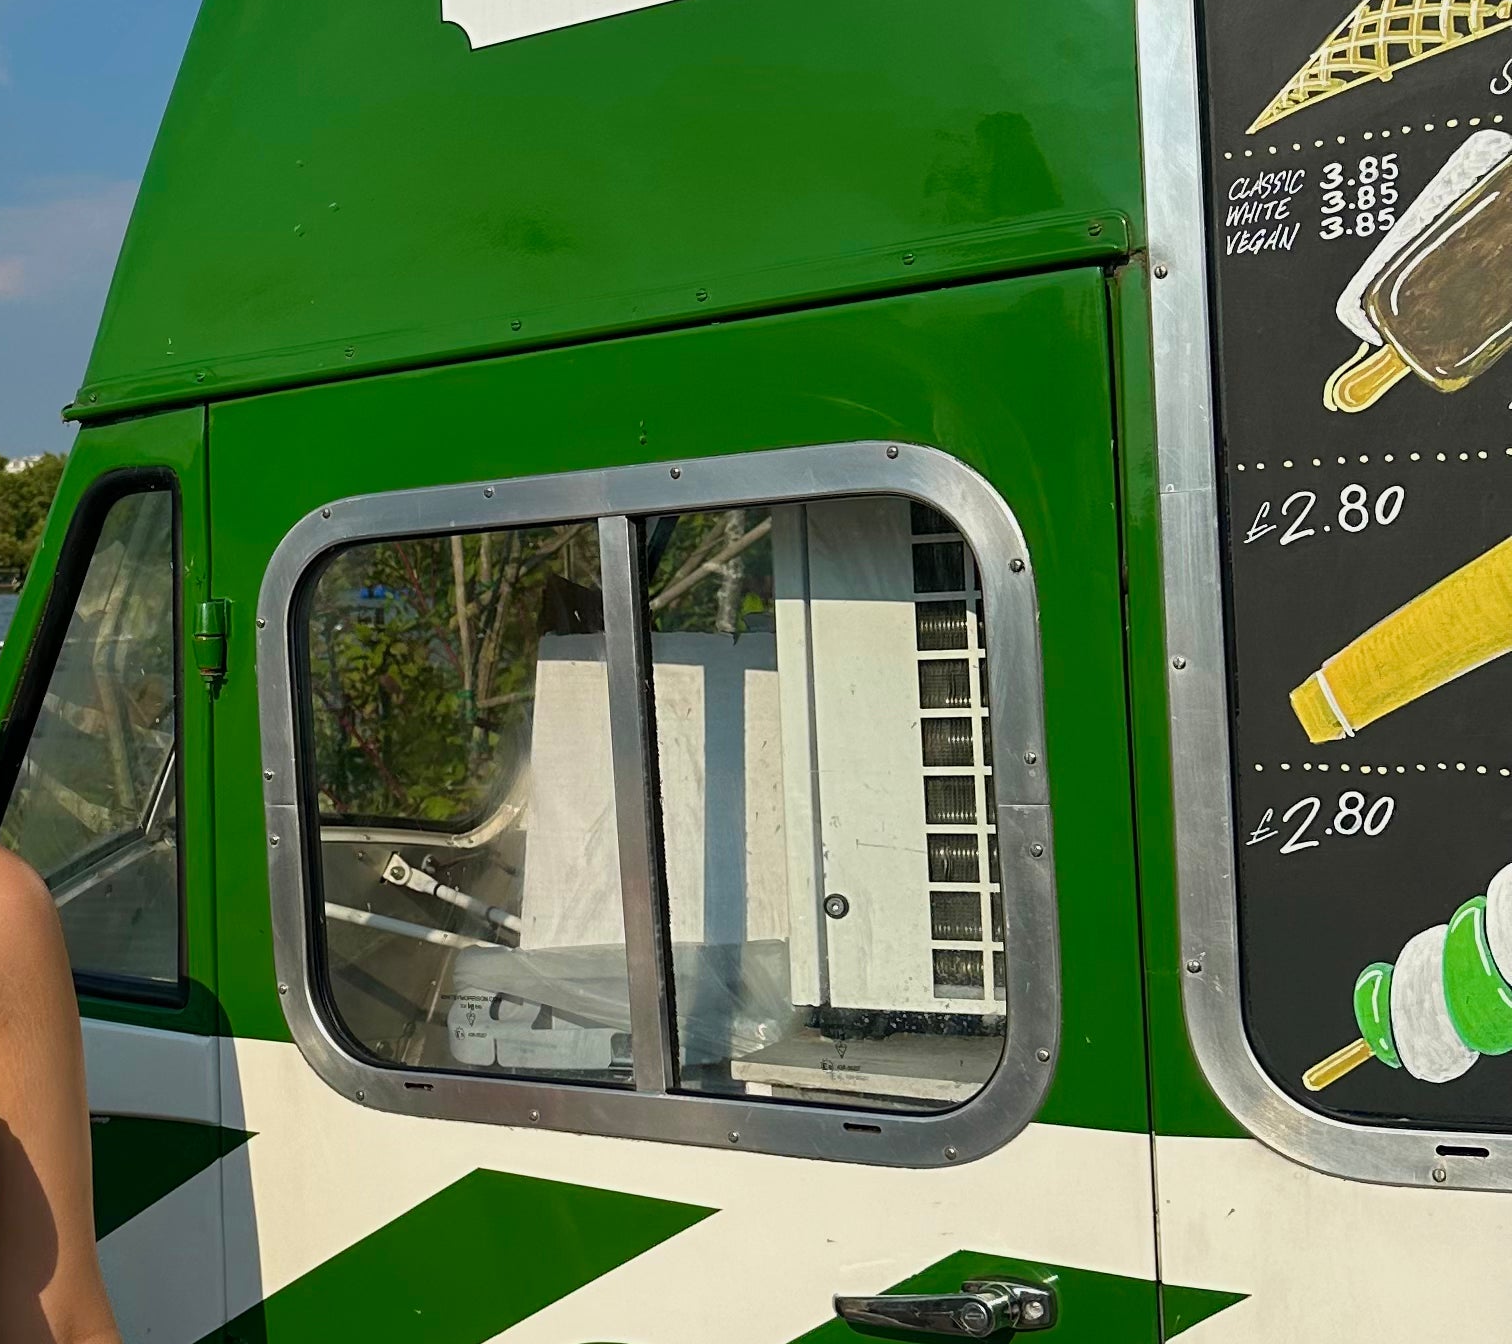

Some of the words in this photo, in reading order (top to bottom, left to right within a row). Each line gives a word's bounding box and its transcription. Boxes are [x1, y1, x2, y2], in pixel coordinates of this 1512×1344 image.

[1228, 169, 1306, 201] CLASSIC
[1319, 153, 1399, 190] 3.85
[1225, 197, 1292, 227] WHITE
[1320, 181, 1399, 214] 3.85
[1225, 222, 1301, 256] VEGAN
[1319, 207, 1396, 240] 3.85
[1243, 483, 1405, 546] £2.80
[1245, 790, 1395, 854] £2.80
